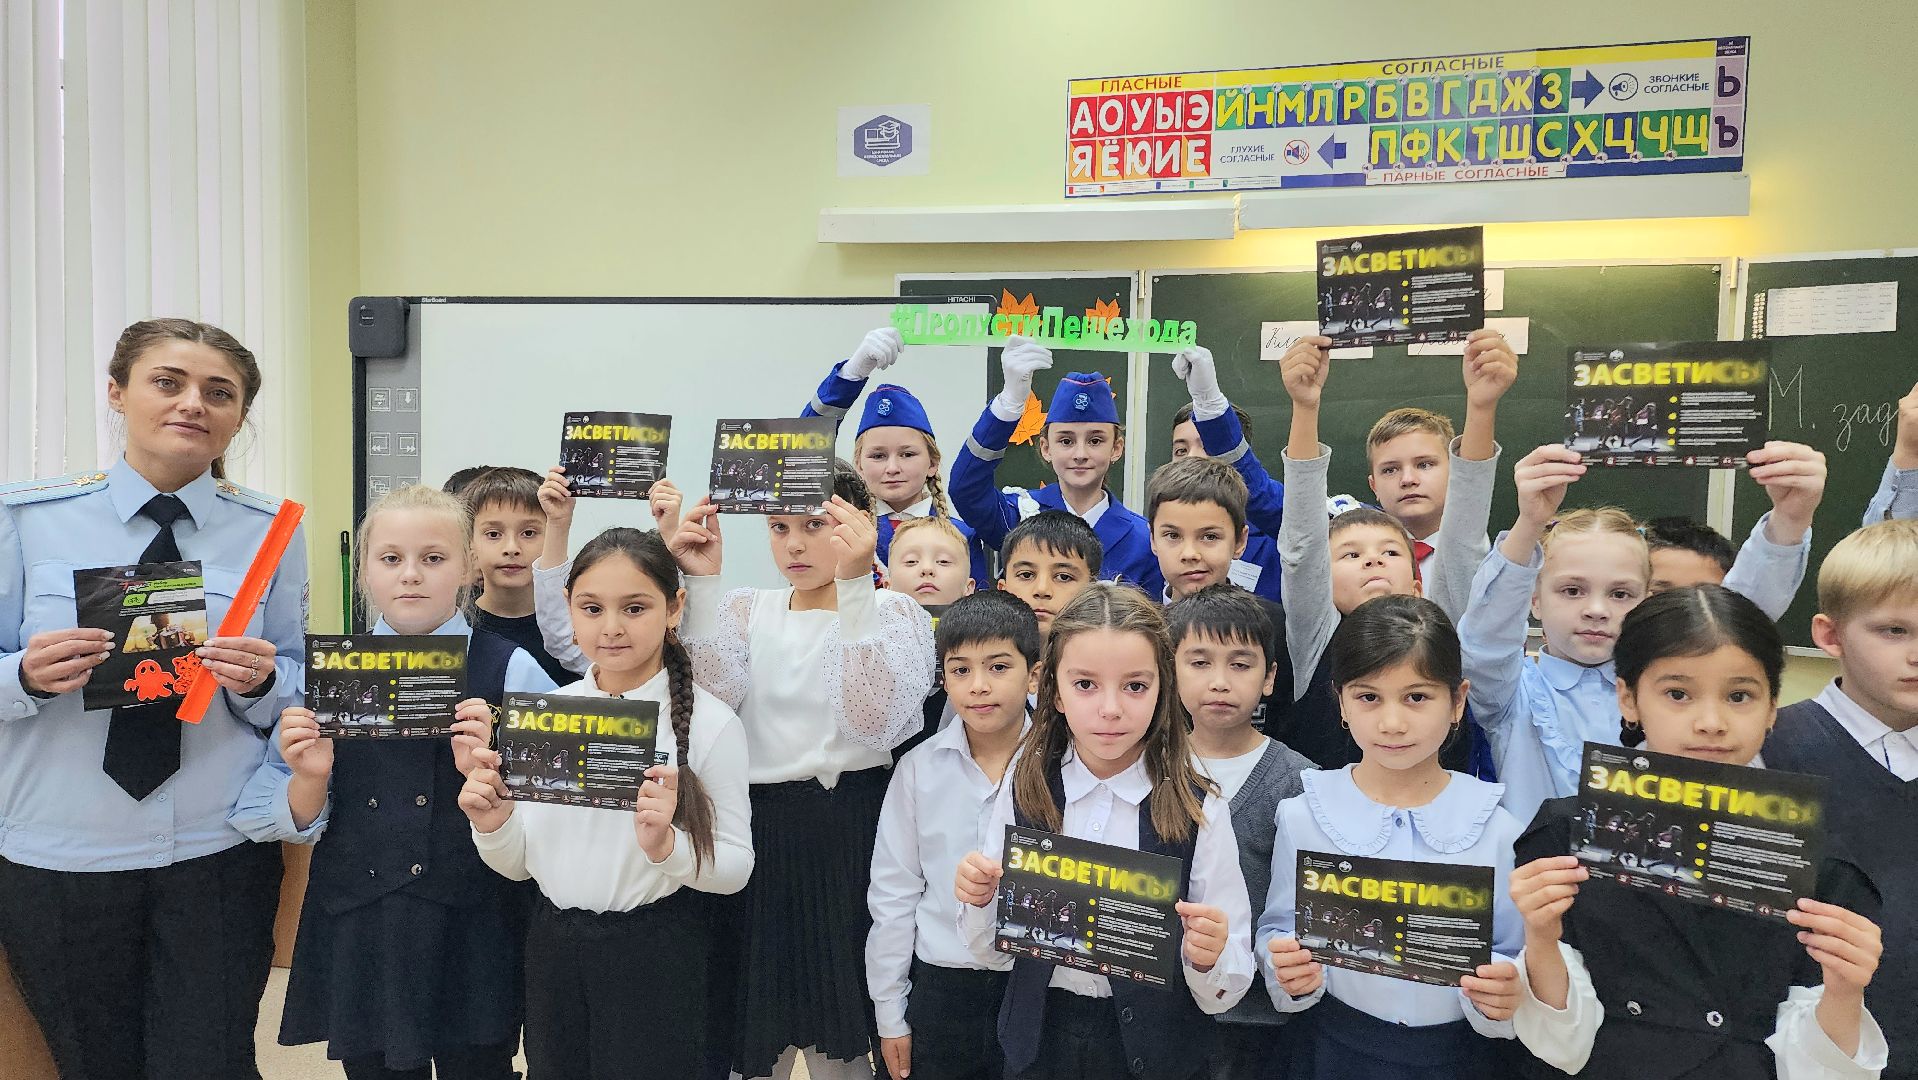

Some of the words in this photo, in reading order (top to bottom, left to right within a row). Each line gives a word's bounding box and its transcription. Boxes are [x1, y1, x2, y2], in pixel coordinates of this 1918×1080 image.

[1382, 56, 1504, 76] СОГЛАСНЫЕ
[1101, 76, 1182, 93] ГЛАСНЫЕ
[1649, 73, 1700, 84] ЗВОНКИЕ
[1644, 82, 1710, 94] СОГЛАСНЫЕ
[1231, 144, 1265, 154] ГЛУХИЕ
[1220, 153, 1275, 164] СОГЛАСНЫЕ
[1383, 170, 1446, 183] ПАРНЫЕ
[1454, 165, 1549, 180] СОГЛАСНЫЕ
[892, 303, 1198, 345] #ПропустиПешехода
